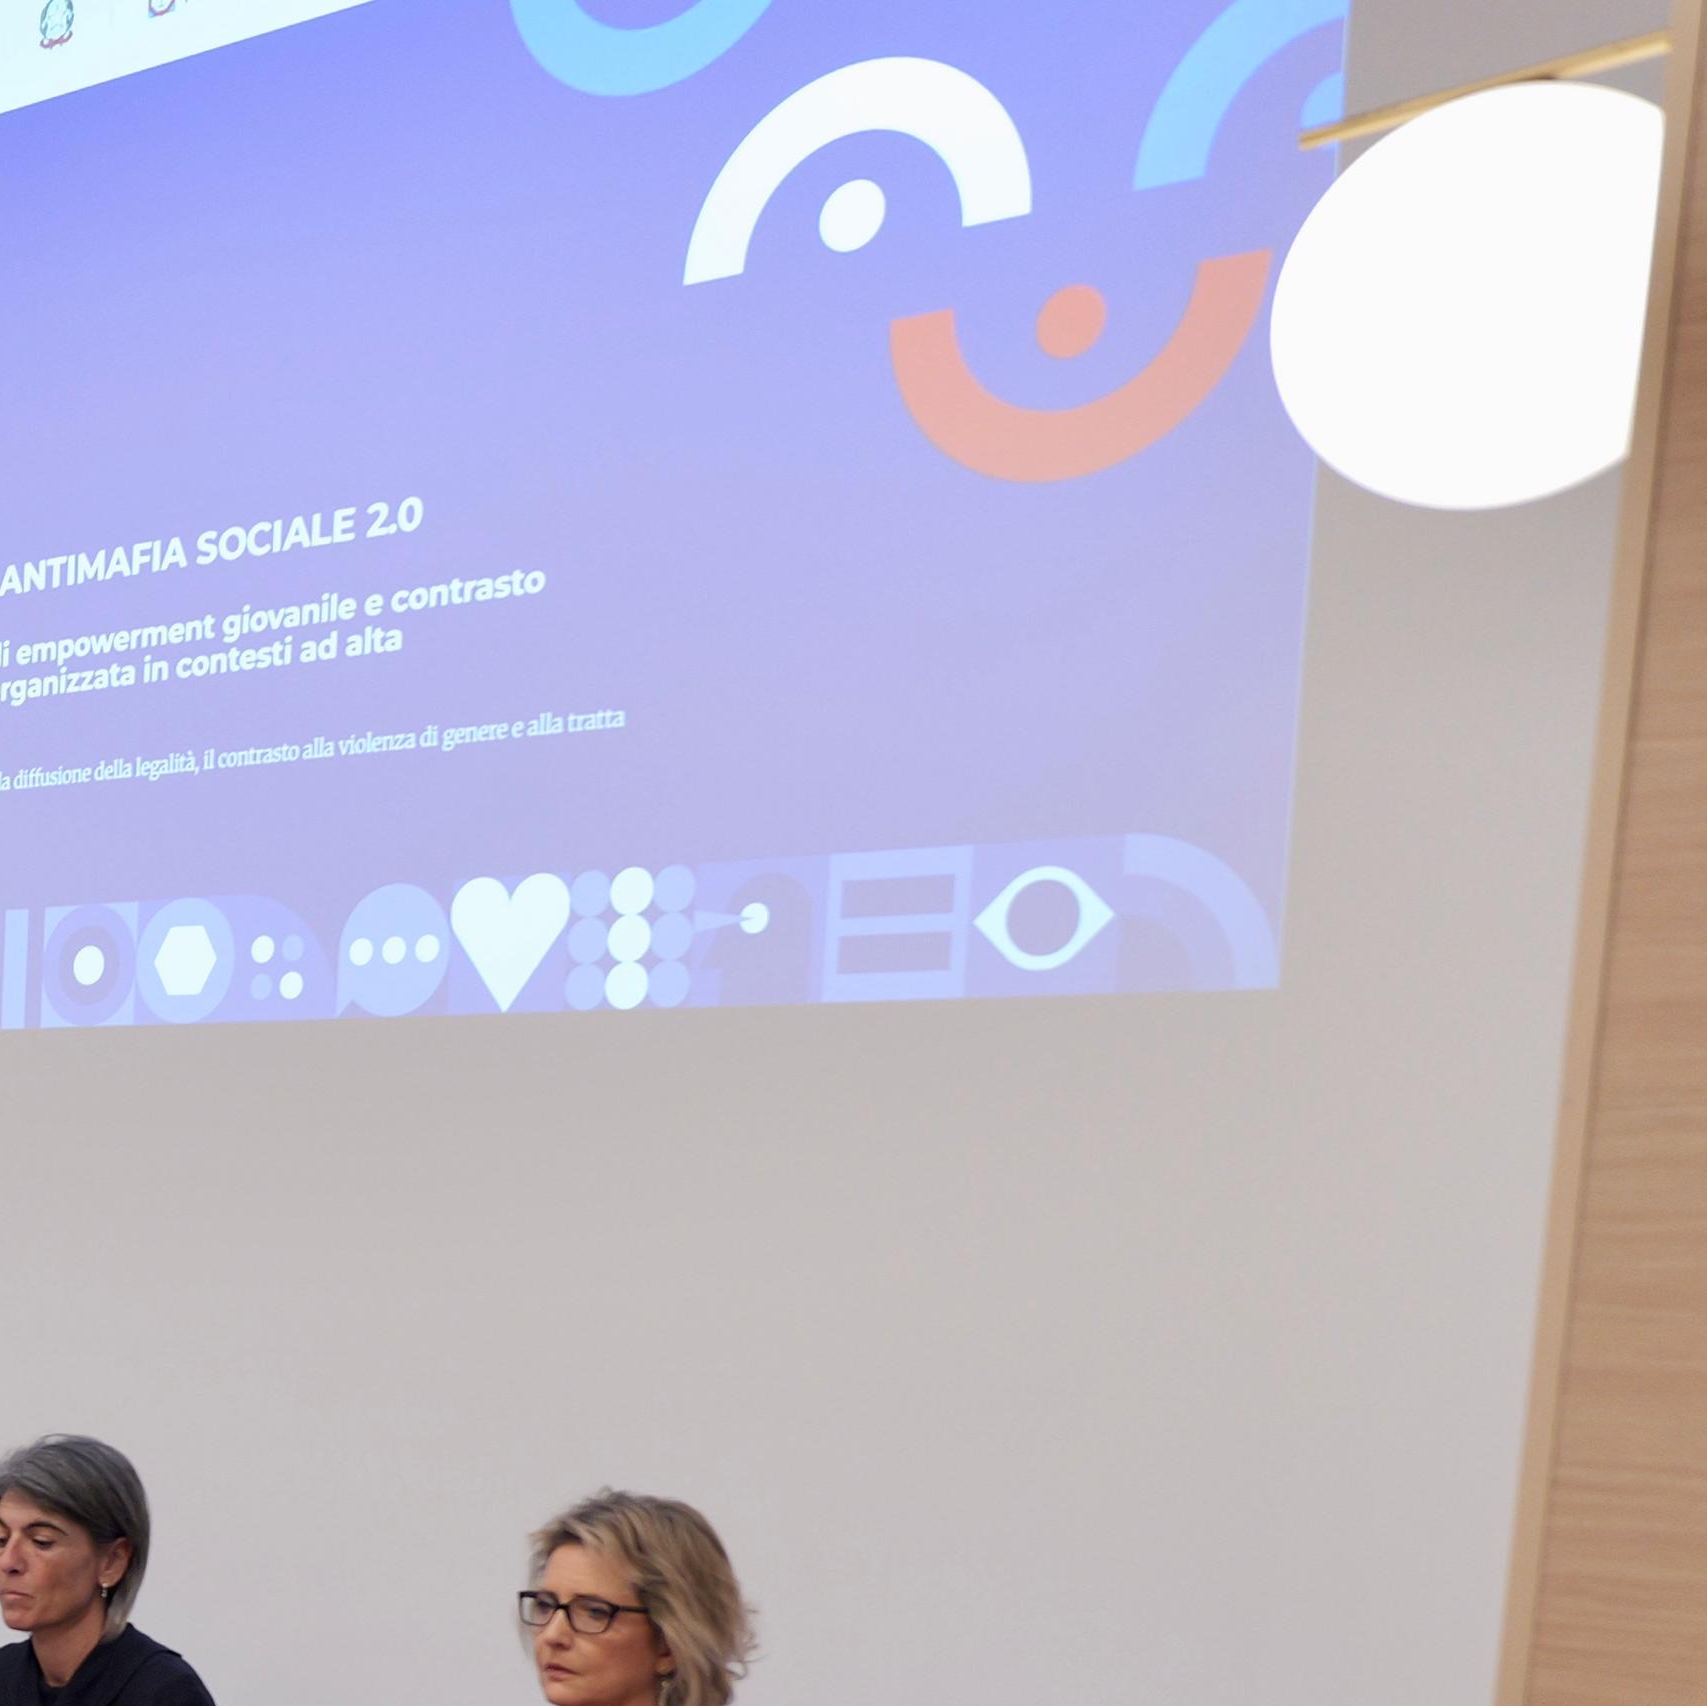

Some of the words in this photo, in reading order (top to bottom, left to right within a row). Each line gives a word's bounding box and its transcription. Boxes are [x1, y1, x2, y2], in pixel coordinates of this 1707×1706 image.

[196, 507, 356, 565] SOCIALE
[366, 496, 423, 538] 2.0
[16, 614, 216, 666] empowerment
[222, 593, 357, 643] giovanile
[364, 594, 384, 616] e
[391, 569, 546, 612] contrasto
[144, 654, 169, 683] in
[176, 635, 293, 678] contesti
[300, 630, 338, 663] ad
[345, 626, 403, 657] alta
[13, 766, 92, 789] diffusione
[94, 759, 132, 781] della
[136, 750, 200, 781] legalità,
[203, 749, 214, 770] il
[218, 744, 300, 768] contrasto
[302, 736, 334, 760] alla
[338, 731, 416, 755] violenza
[420, 725, 438, 747] di
[442, 723, 508, 751] genere
[512, 721, 524, 738] e
[527, 712, 563, 736] alla
[568, 710, 624, 732] tratta
